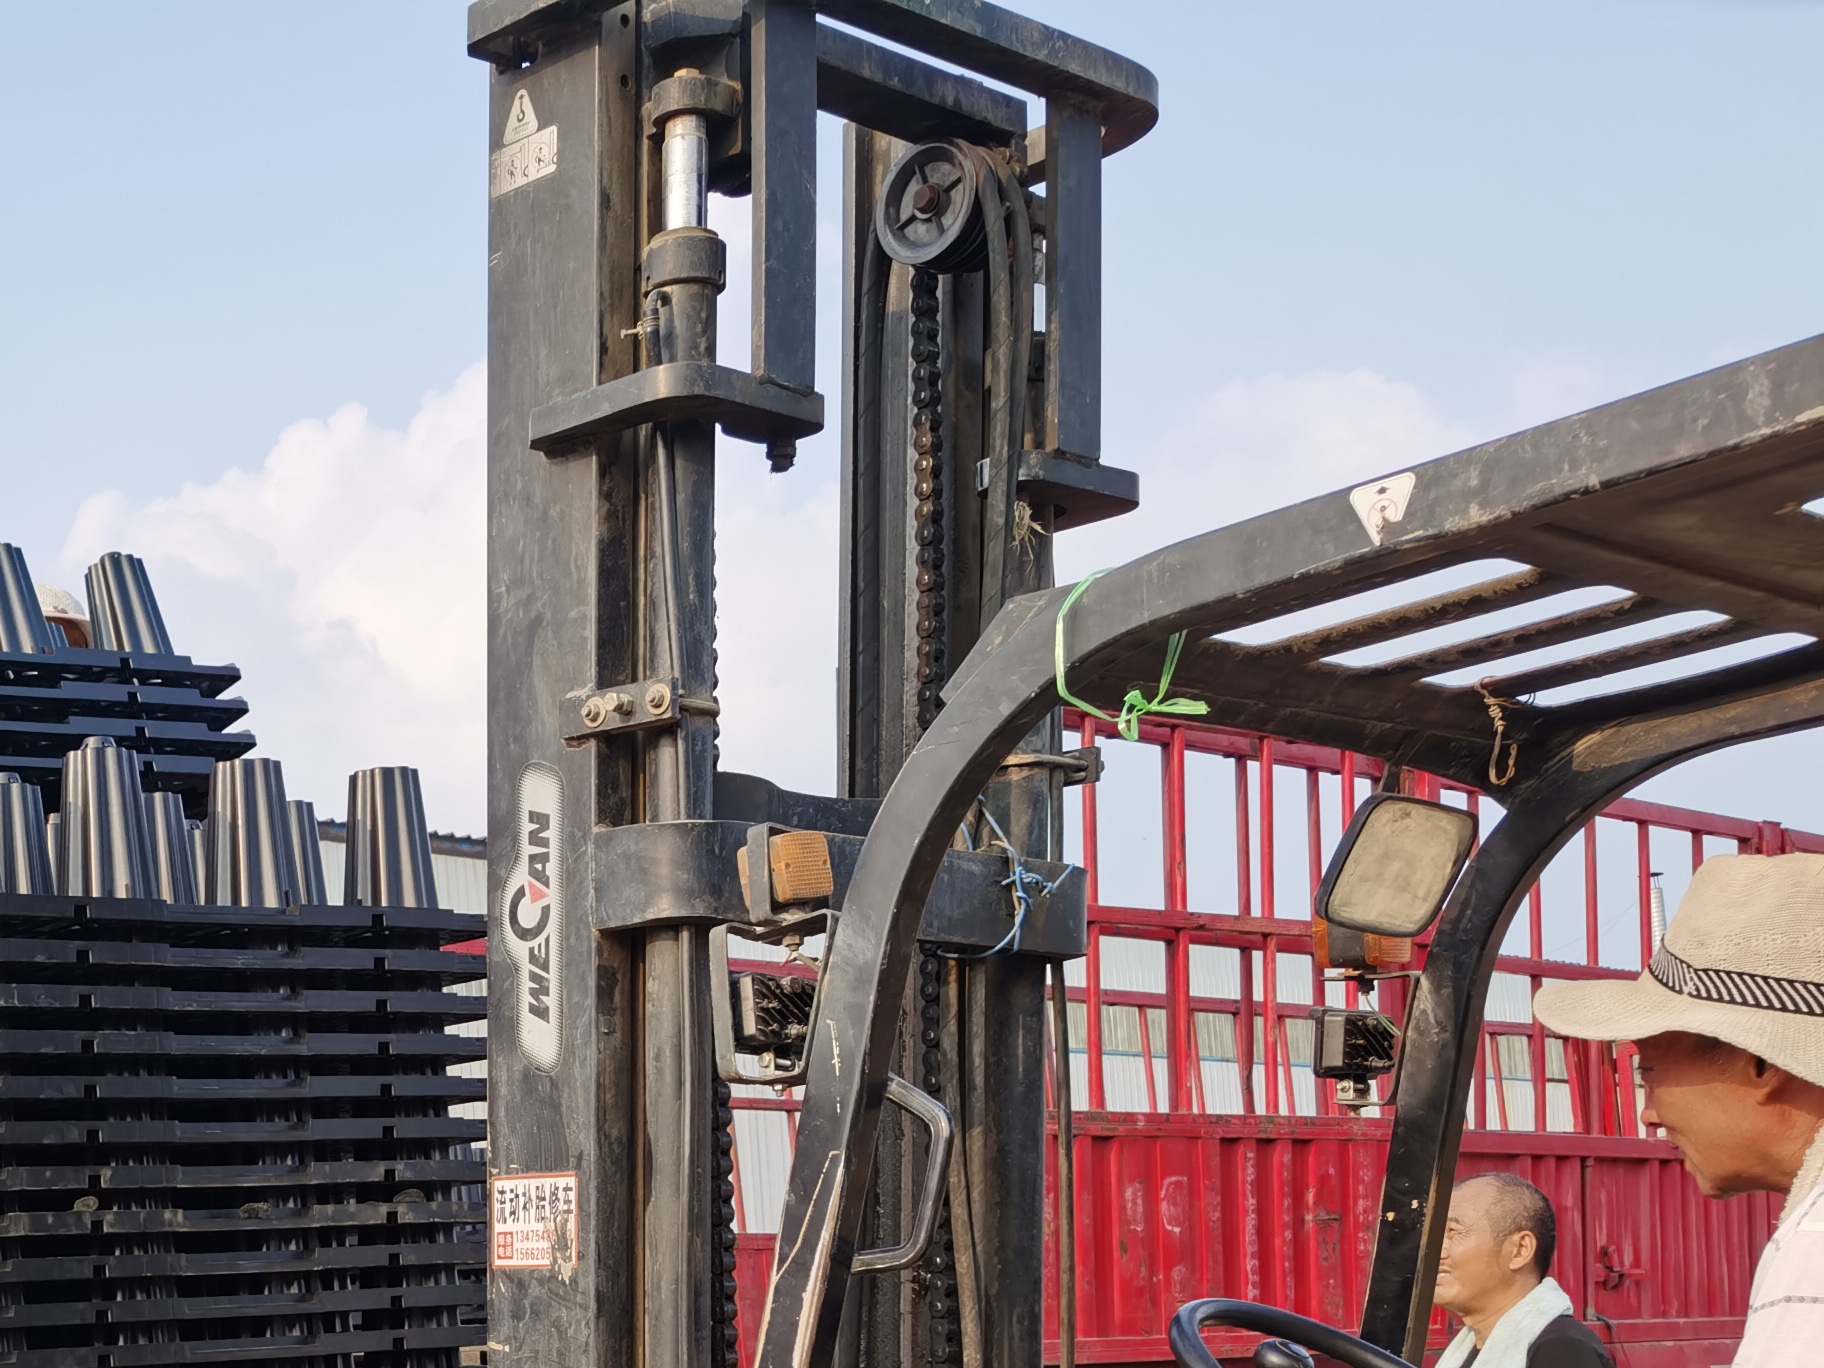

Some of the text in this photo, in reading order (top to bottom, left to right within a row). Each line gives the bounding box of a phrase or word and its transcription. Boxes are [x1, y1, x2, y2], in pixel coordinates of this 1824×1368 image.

[508, 809, 551, 1024] WECAN
[495, 1181, 574, 1225] 流动补胎修车
